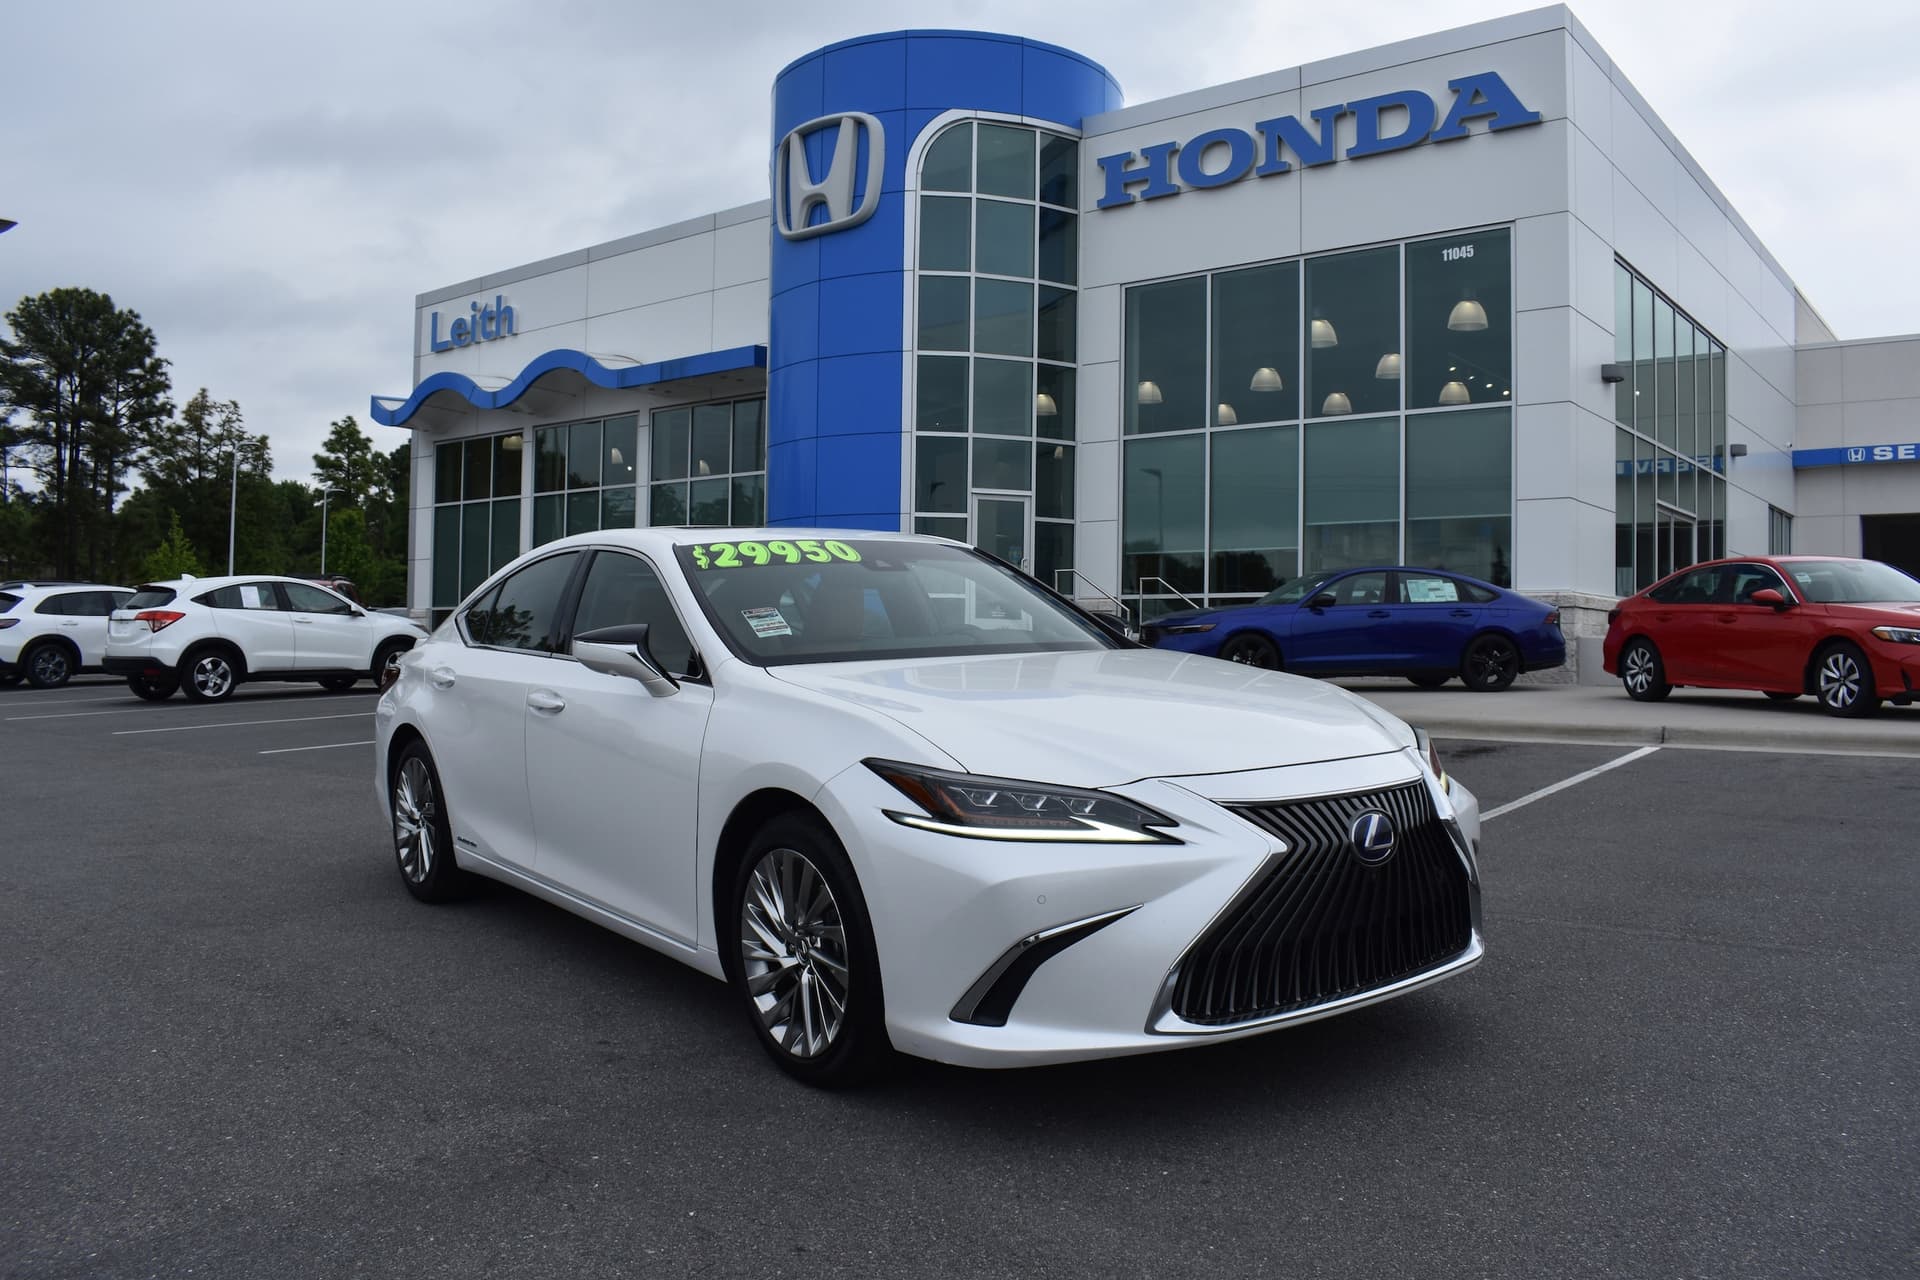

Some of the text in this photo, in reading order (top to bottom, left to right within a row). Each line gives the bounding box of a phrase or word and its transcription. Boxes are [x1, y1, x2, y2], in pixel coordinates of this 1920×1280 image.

[1097, 71, 1540, 208] HONDA
[1442, 245, 1474, 261] 11045
[431, 294, 514, 352] Leith
[1873, 445, 1916, 460] SE
[692, 540, 862, 569] $29950
